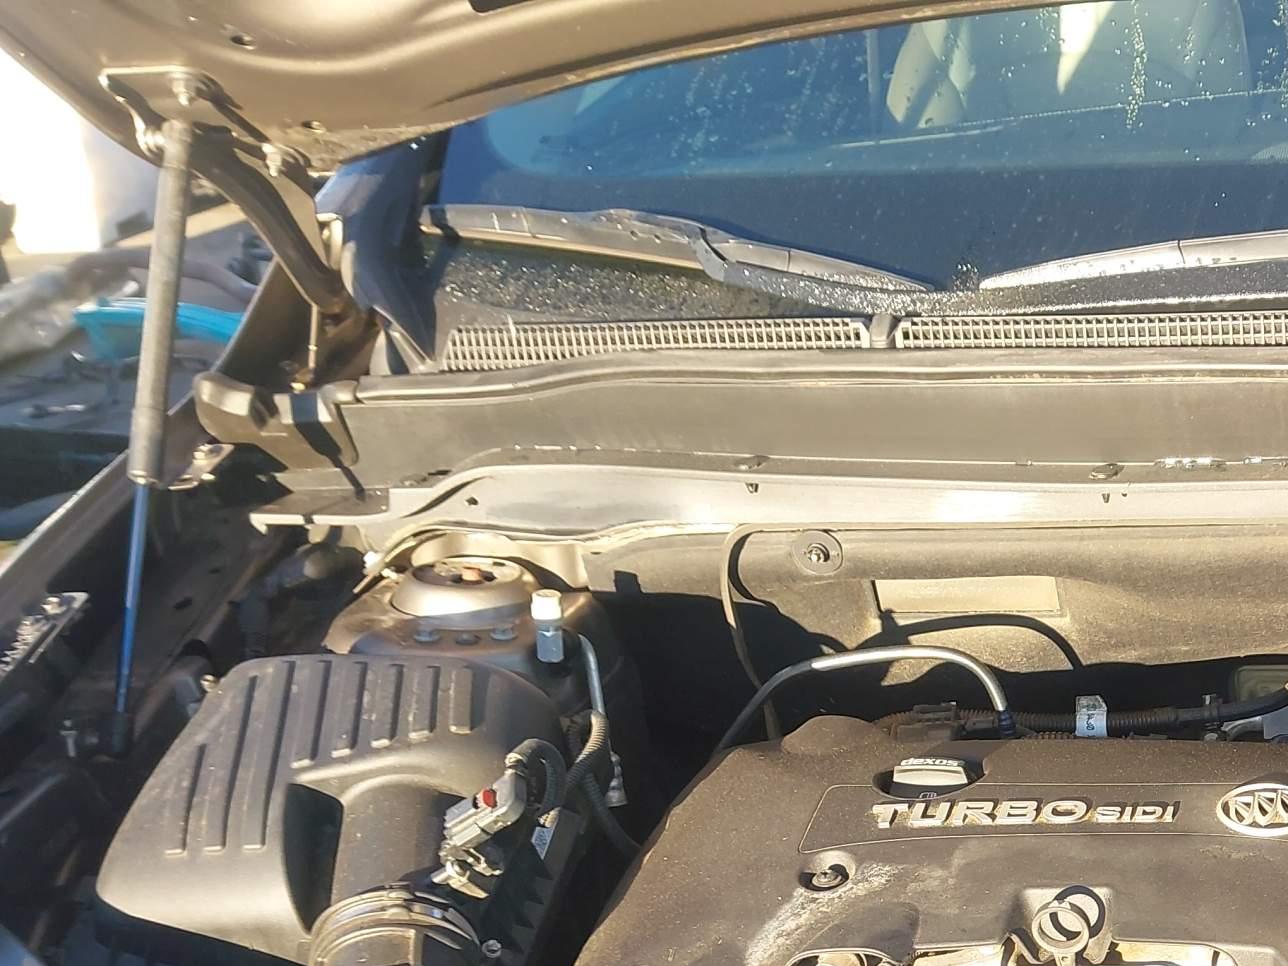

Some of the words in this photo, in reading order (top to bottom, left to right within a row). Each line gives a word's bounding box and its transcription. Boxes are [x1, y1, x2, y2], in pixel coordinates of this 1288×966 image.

[900, 757, 962, 768] dexos
[872, 801, 1088, 829] TURBO
[1095, 803, 1176, 824] SIDI
